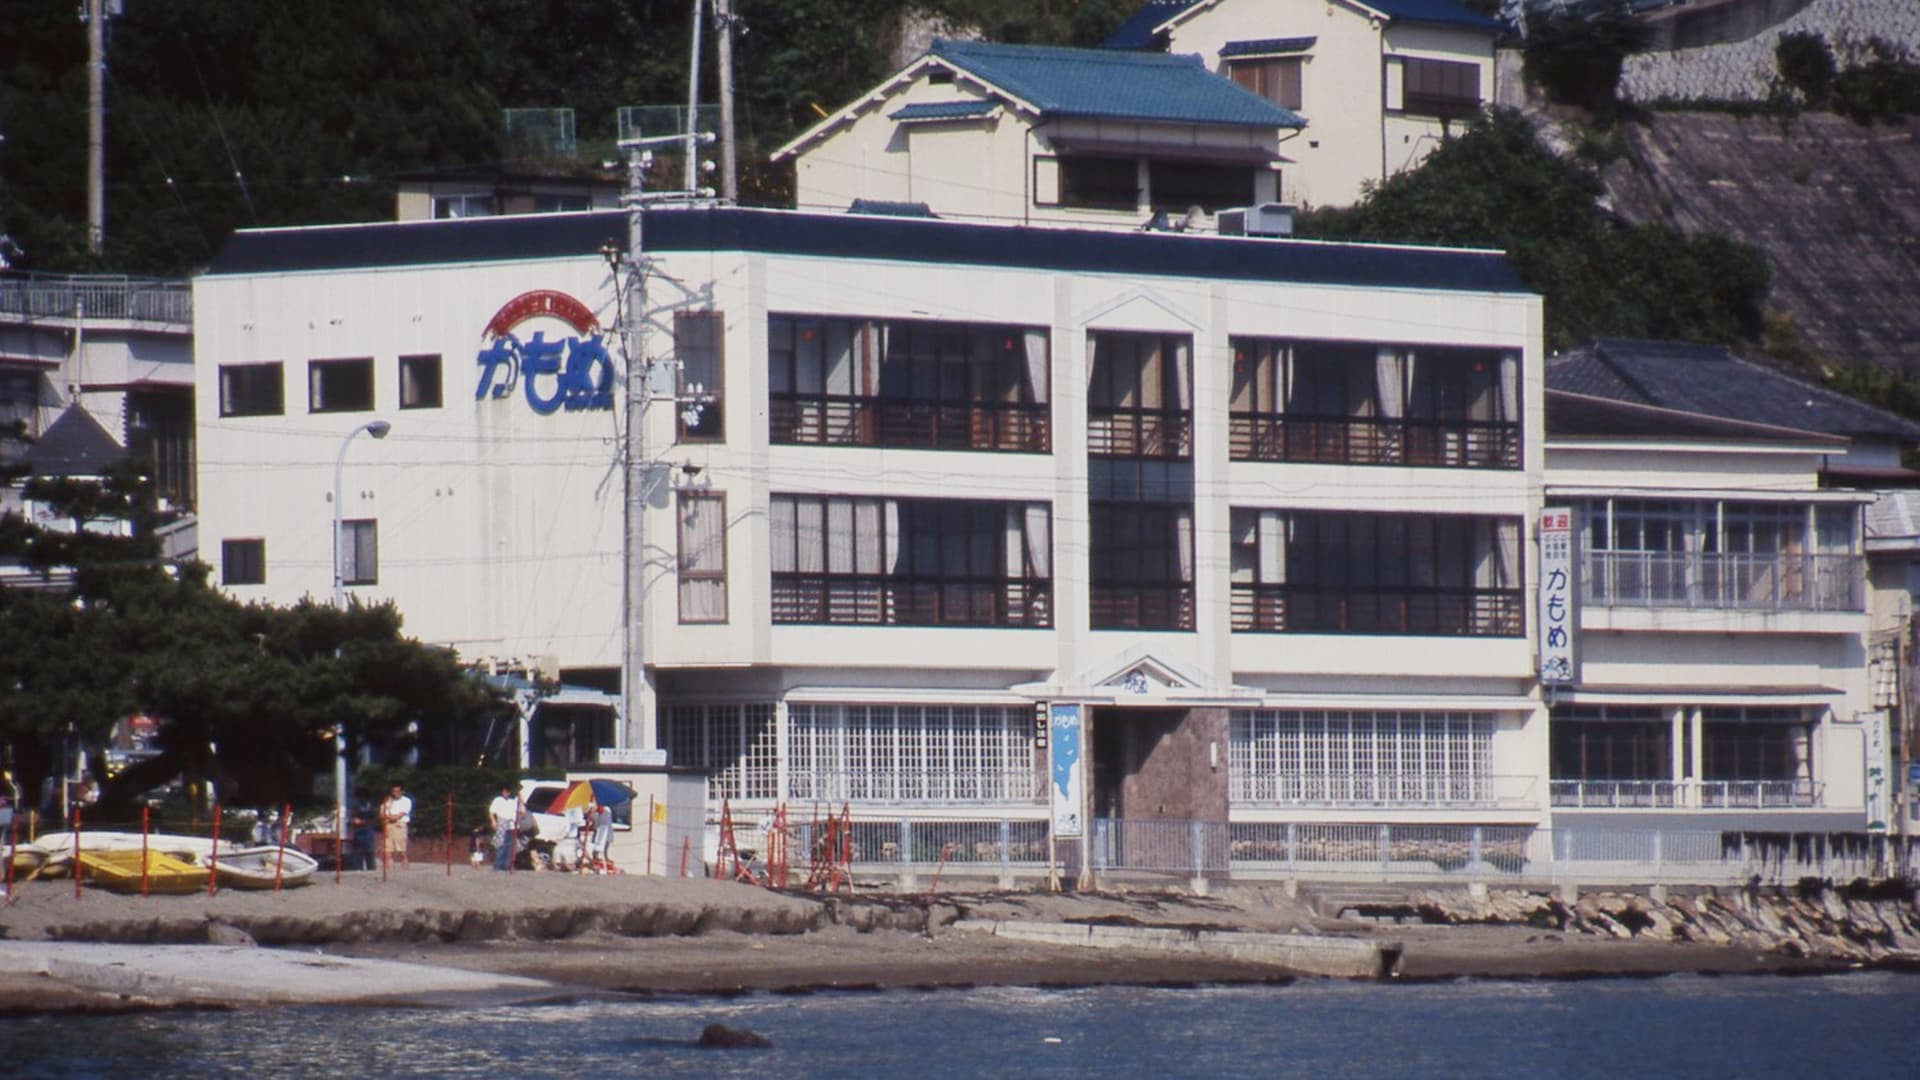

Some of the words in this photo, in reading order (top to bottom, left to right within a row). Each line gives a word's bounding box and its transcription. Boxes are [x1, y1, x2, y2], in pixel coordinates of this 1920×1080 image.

[475, 331, 615, 415] かもめ
[1547, 568, 1568, 648] かもめ
